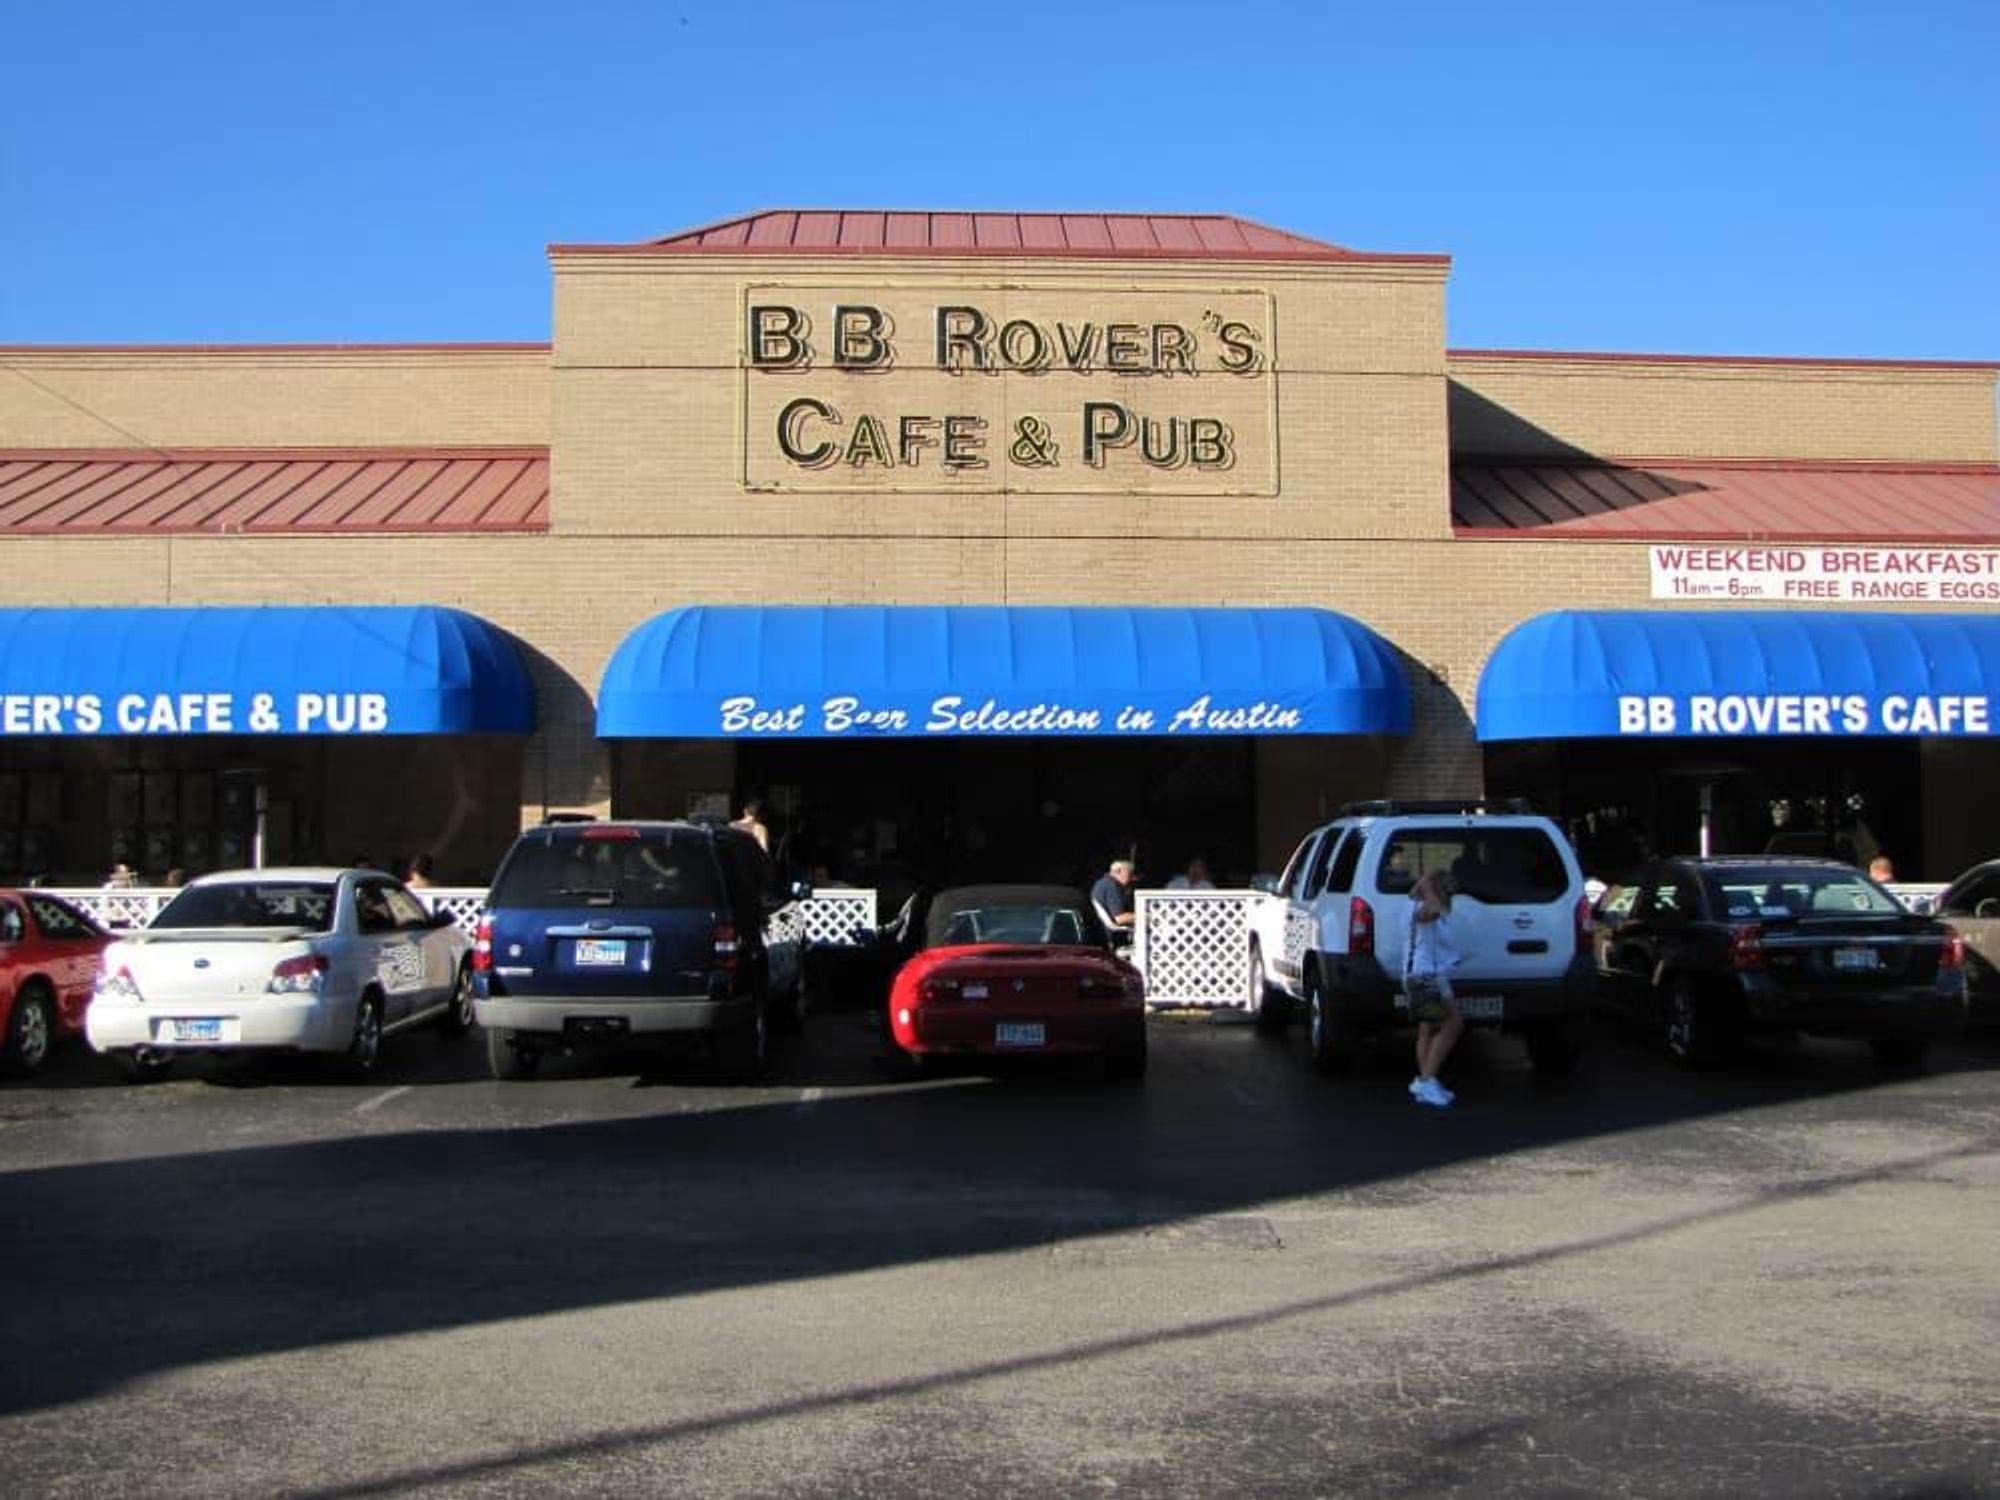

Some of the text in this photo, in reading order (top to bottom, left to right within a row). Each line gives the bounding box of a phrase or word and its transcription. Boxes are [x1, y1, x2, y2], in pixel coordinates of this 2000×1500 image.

[750, 304, 1263, 377] B B ROVER'S
[777, 397, 1237, 474] CAFE & PUB
[1656, 549, 1999, 574] WEEKEND BREAKFAST
[1784, 580, 1841, 598] FREE
[1852, 581, 1930, 599] RANGE
[1940, 582, 2000, 599] EGGS
[0, 693, 388, 734] ER'S CAFE & PUB
[720, 696, 806, 731] Best
[925, 696, 1101, 732] Selection
[1115, 704, 1155, 731] in
[1167, 695, 1302, 733] Austin
[1618, 696, 1989, 734] BB ROVER'S CAFE
